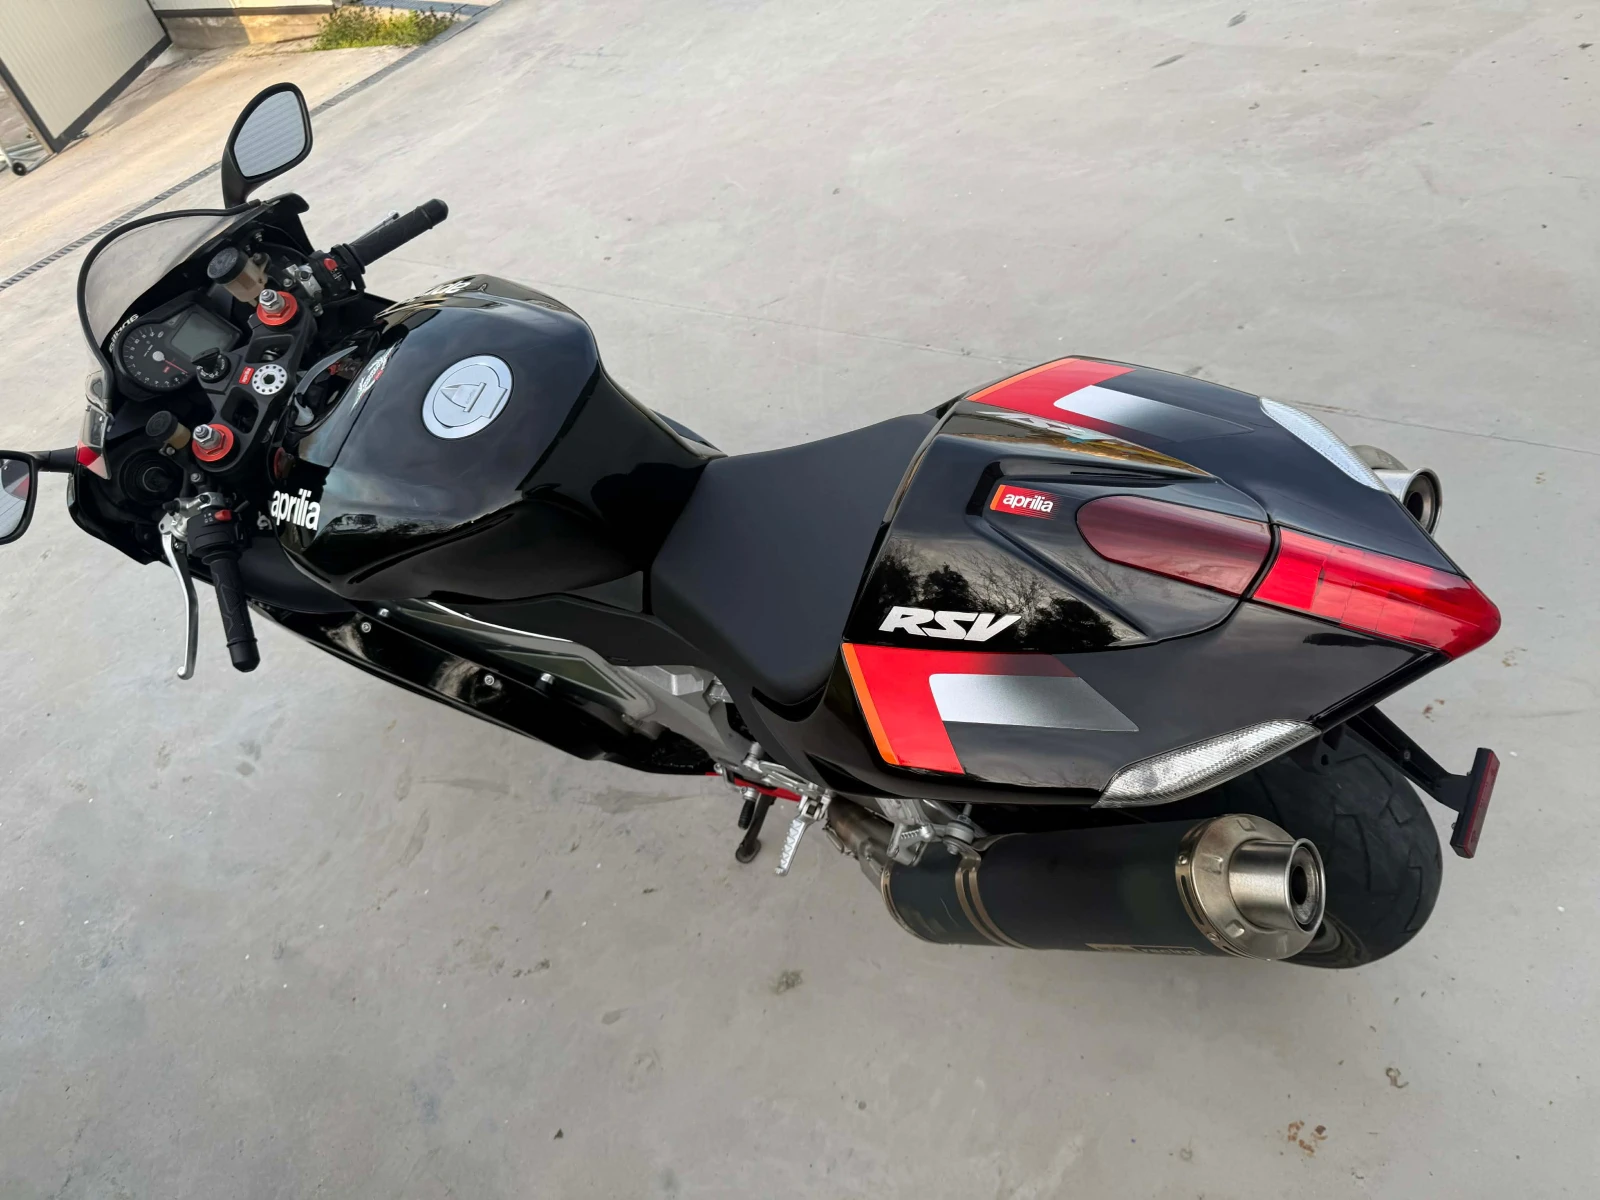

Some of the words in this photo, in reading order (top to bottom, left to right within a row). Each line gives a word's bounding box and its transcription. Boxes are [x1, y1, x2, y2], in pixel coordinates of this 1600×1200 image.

[271, 488, 321, 530] aprilia
[1003, 493, 1053, 513] aprilia
[878, 606, 1022, 642] RSV
